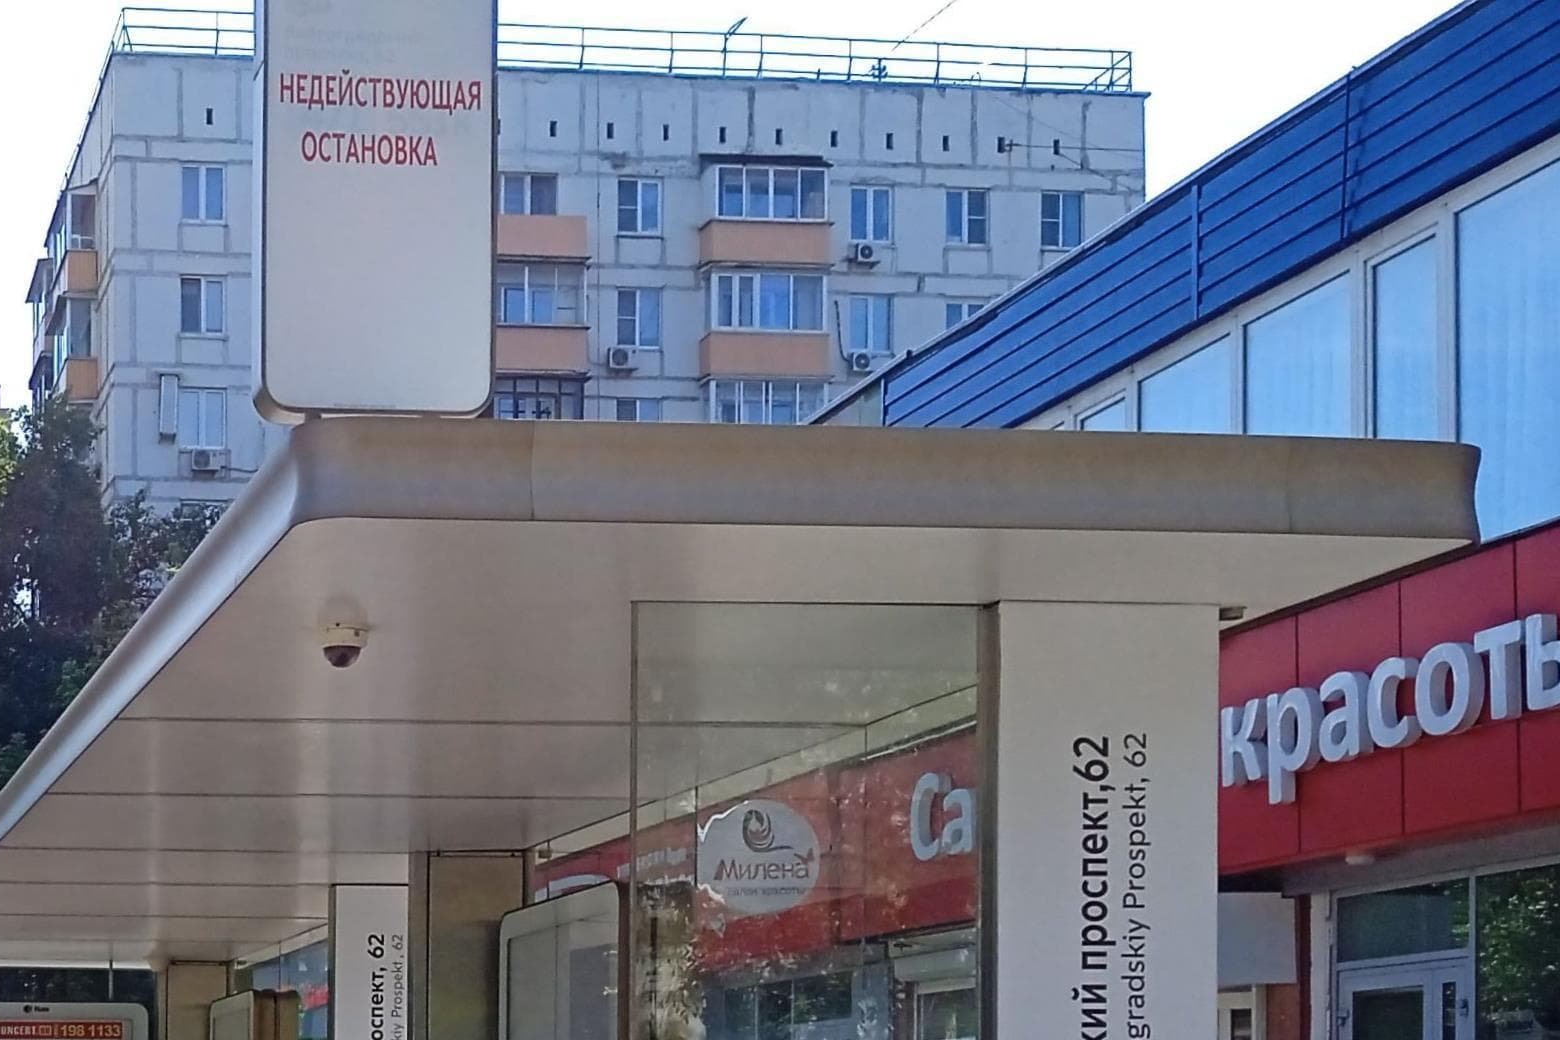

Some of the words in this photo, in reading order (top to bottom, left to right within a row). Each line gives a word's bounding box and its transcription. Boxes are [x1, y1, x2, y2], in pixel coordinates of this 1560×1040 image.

[279, 69, 482, 116] НЕДЕЙСТВУЮЩАЯ
[300, 131, 438, 166] ОСТАНОВКА
[1123, 733, 1146, 768] 62
[1122, 777, 1151, 909] Prospekt,
[713, 858, 809, 880] Милена
[367, 934, 384, 958] 62
[391, 935, 403, 950] 62
[60, 1024, 85, 1037] 198
[88, 1024, 121, 1037] 1133
